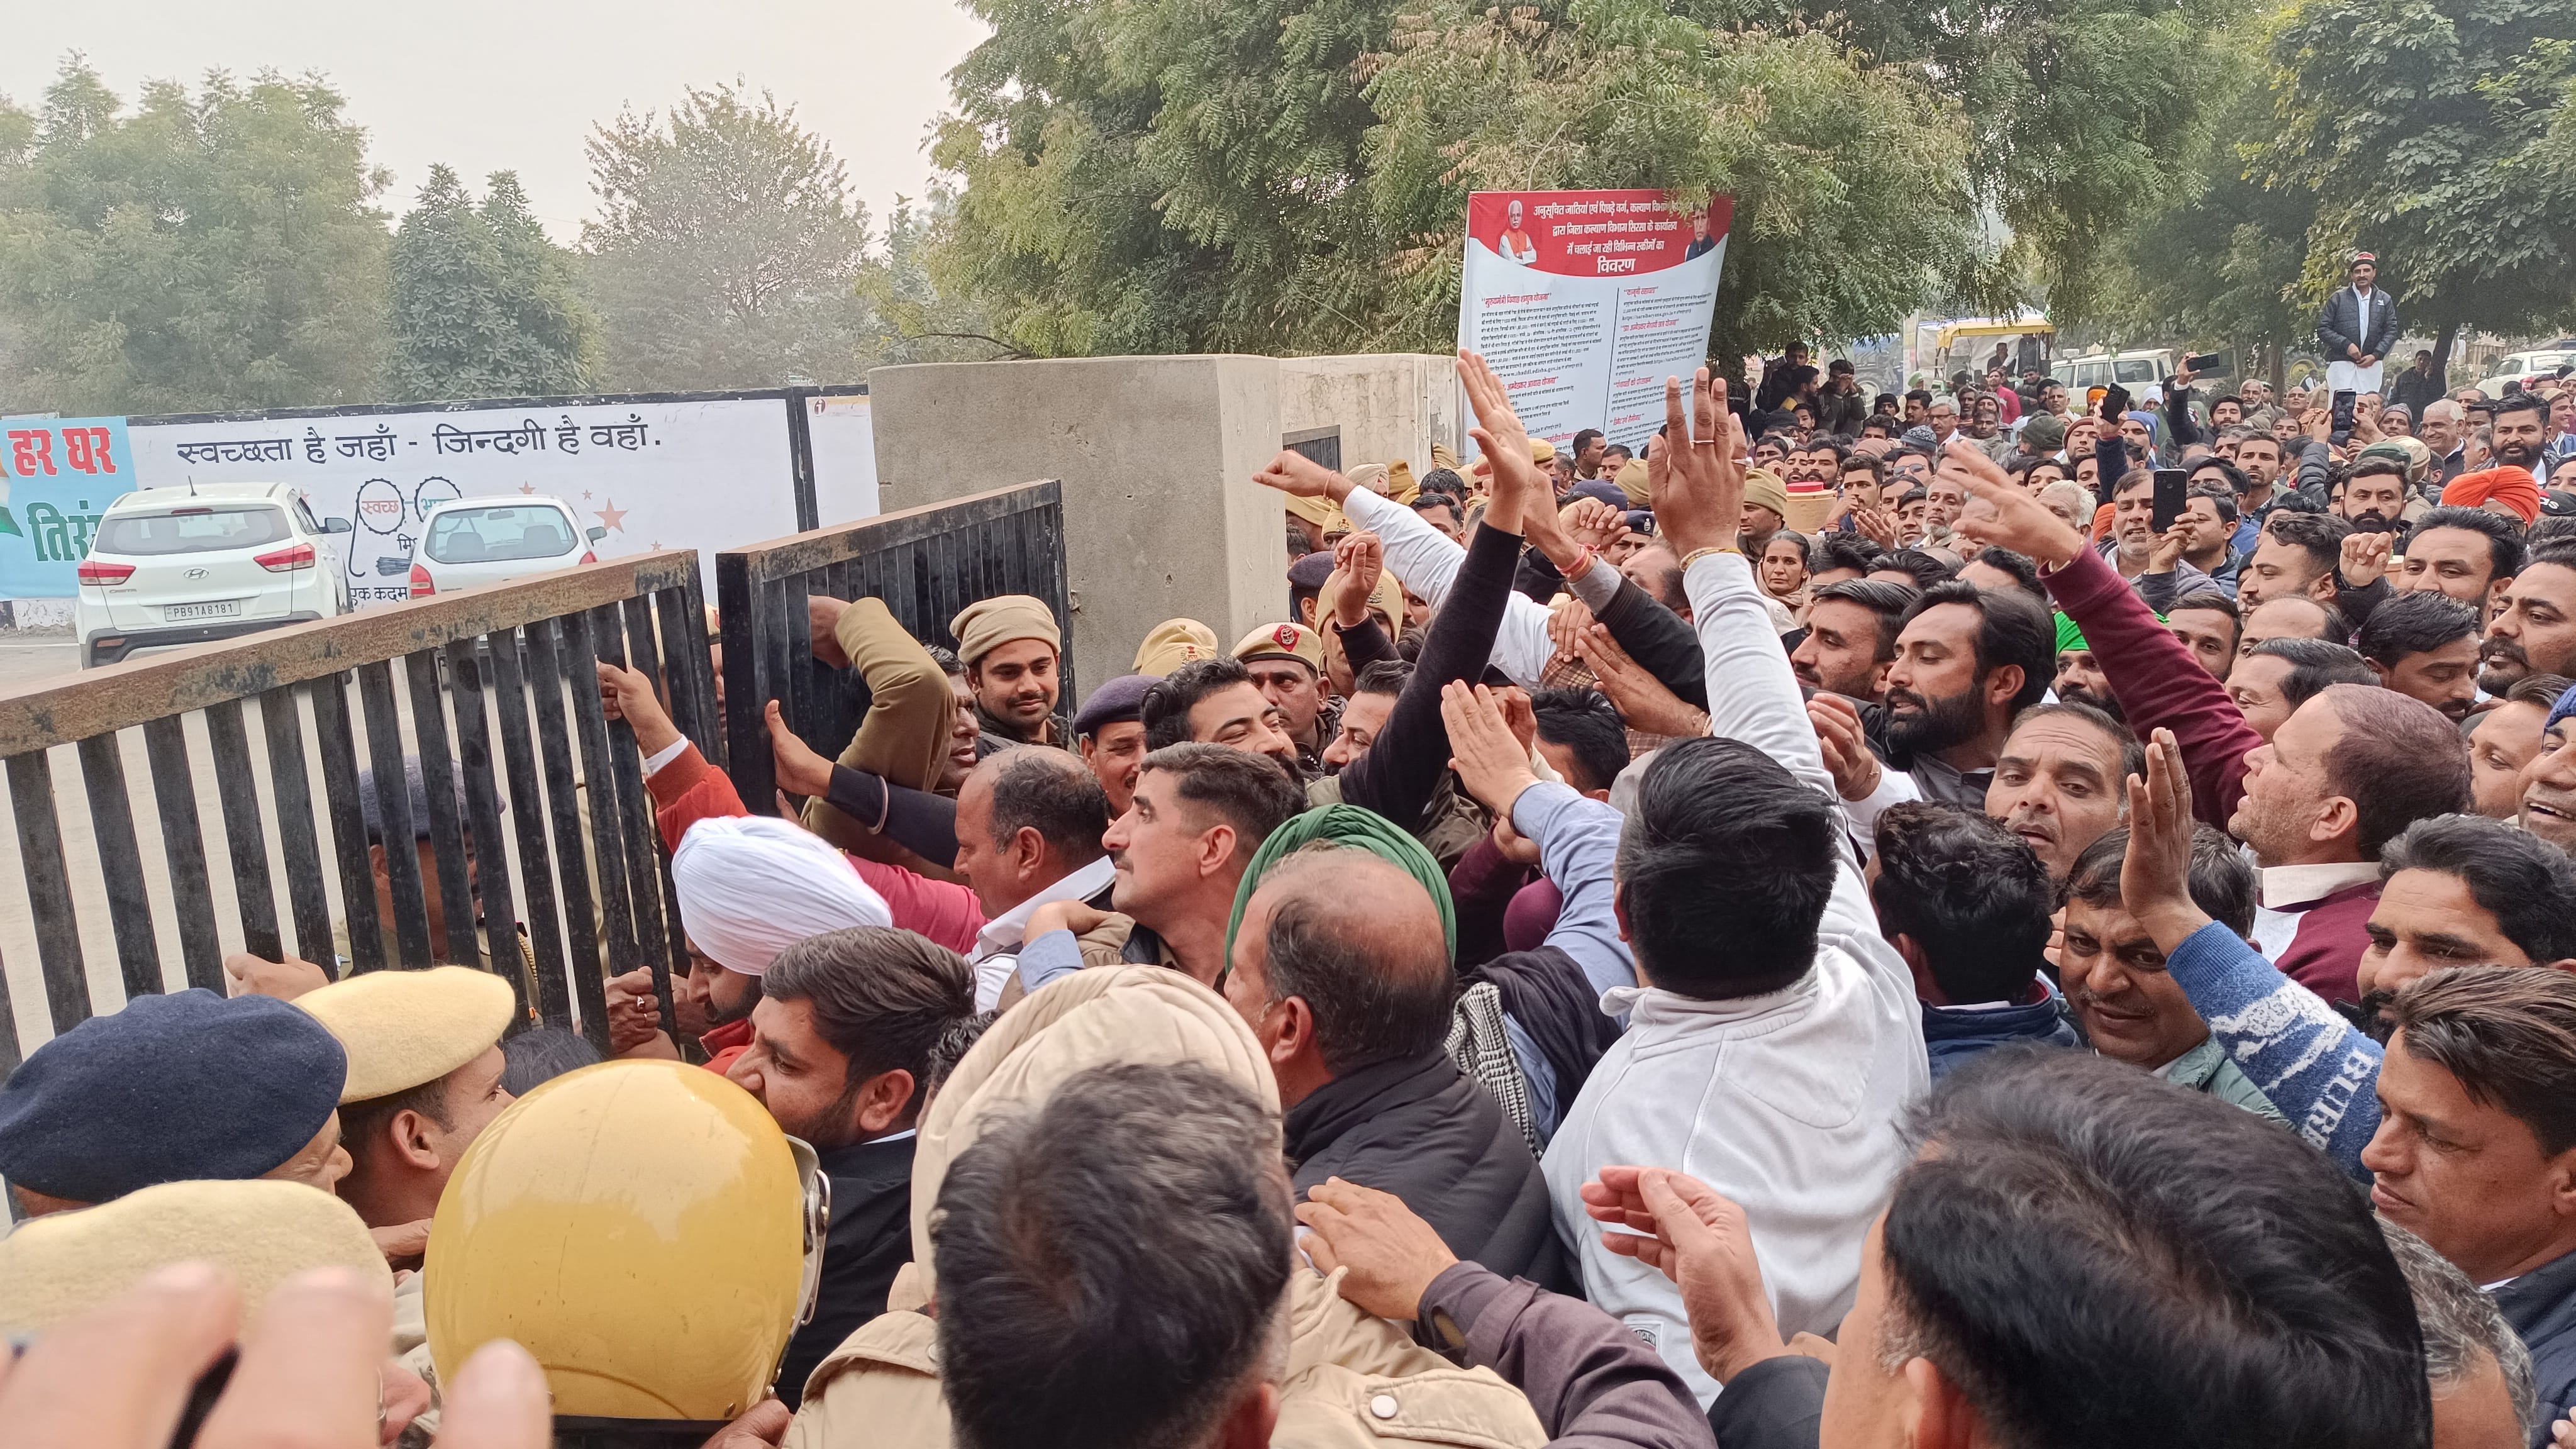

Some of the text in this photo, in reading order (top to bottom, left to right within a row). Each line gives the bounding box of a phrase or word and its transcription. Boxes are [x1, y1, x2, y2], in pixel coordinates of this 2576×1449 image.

[1533, 202, 1565, 219] अनुसूचित
[1589, 200, 1599, 215] एवं
[1630, 203, 1652, 213] कल्याण
[1552, 218, 1677, 237] द्वारा जिला कल्याण विभाग सिरसा के कार्यालय
[1574, 240, 1594, 255] चलाई
[1593, 244, 1602, 253] जा
[1602, 240, 1613, 253] रही
[1614, 239, 1636, 252] विभिन्न
[1656, 240, 1665, 250] का
[1597, 255, 1636, 274] विवरण
[177, 438, 292, 465] स्वच्छता
[303, 426, 327, 464] है
[335, 423, 397, 462] जहाँ
[432, 418, 547, 455] जिन्दगी
[555, 414, 581, 455] है
[8, 427, 117, 477] हर घर
[362, 500, 399, 514] स्वच्छ
[350, 587, 408, 606] एक कदम
[174, 602, 234, 618] PB91A8181
